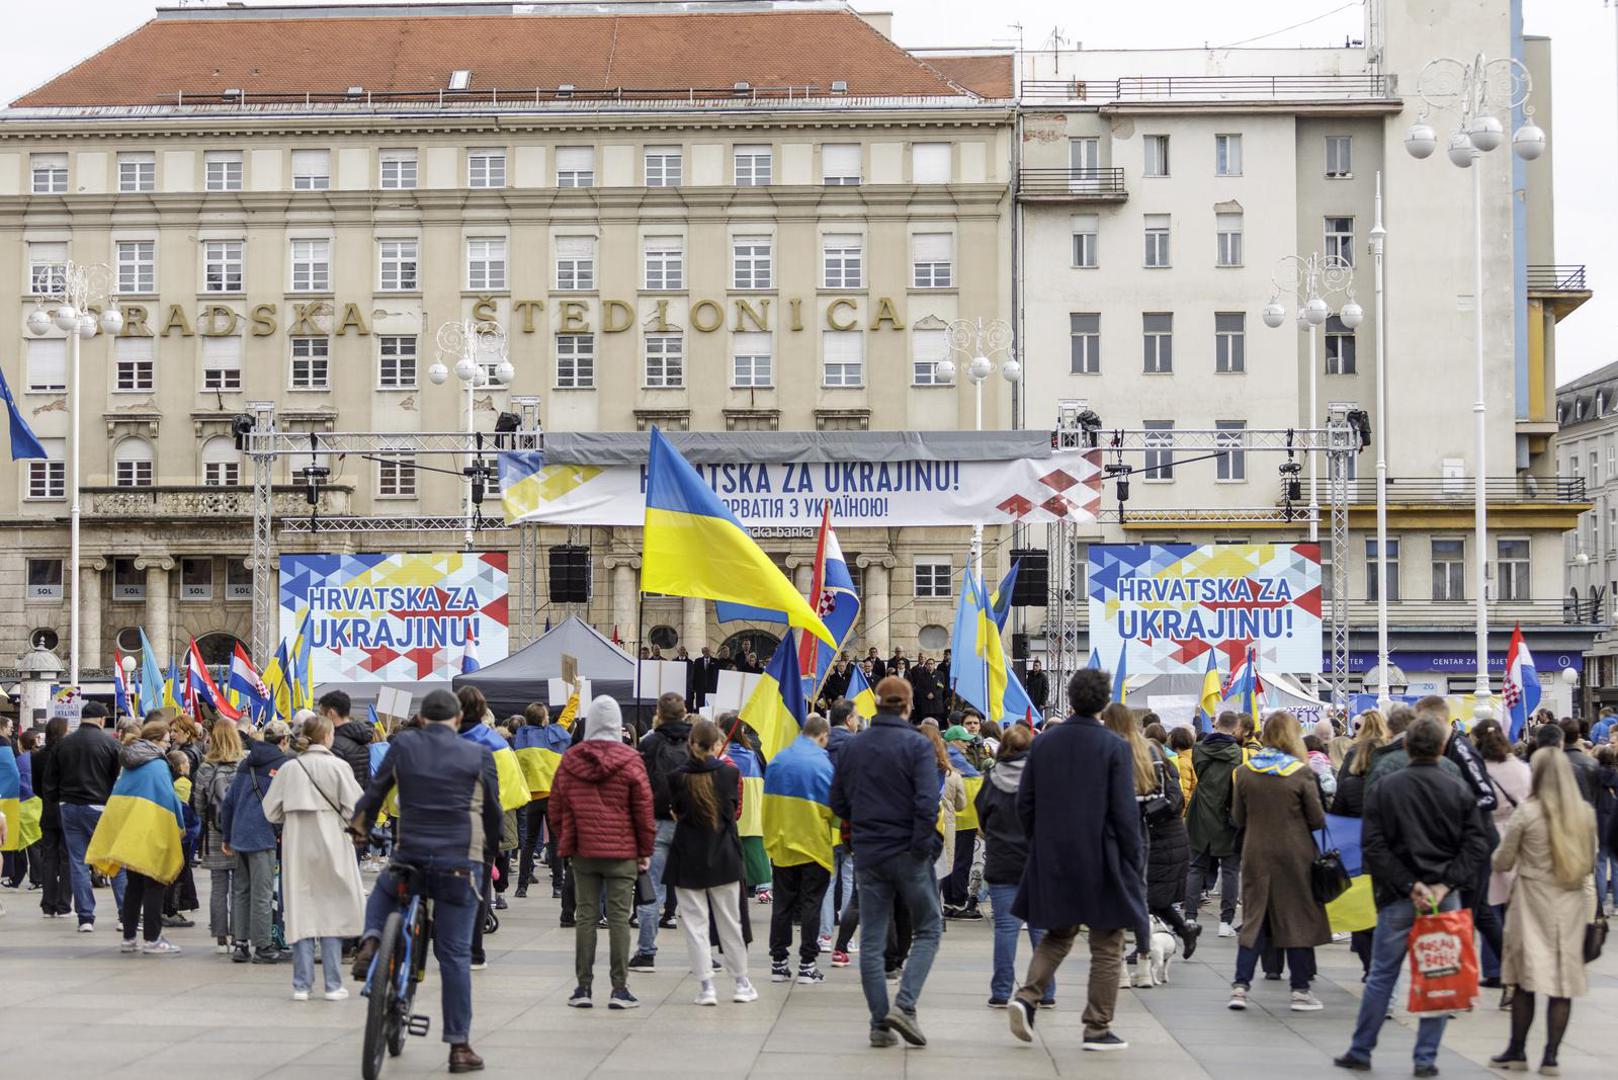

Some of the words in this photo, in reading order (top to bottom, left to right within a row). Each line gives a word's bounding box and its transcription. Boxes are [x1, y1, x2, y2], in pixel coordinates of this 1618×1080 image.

[472, 295, 905, 333] ŠTEDIONICA
[782, 462, 813, 493] ZA
[825, 461, 959, 493] UKRAJINU!
[777, 527, 814, 538] banka
[38, 587, 52, 595] SOL
[124, 587, 139, 595] SOL
[190, 587, 204, 595] SOL
[235, 587, 250, 595] SOL
[309, 587, 440, 610] HRVATSKA
[446, 587, 480, 609] ZA
[1118, 578, 1251, 601] HRVATSKA
[1259, 578, 1292, 600] ZA
[311, 617, 480, 647] UKRAJINU!
[1118, 609, 1293, 639] UKRAJINU!
